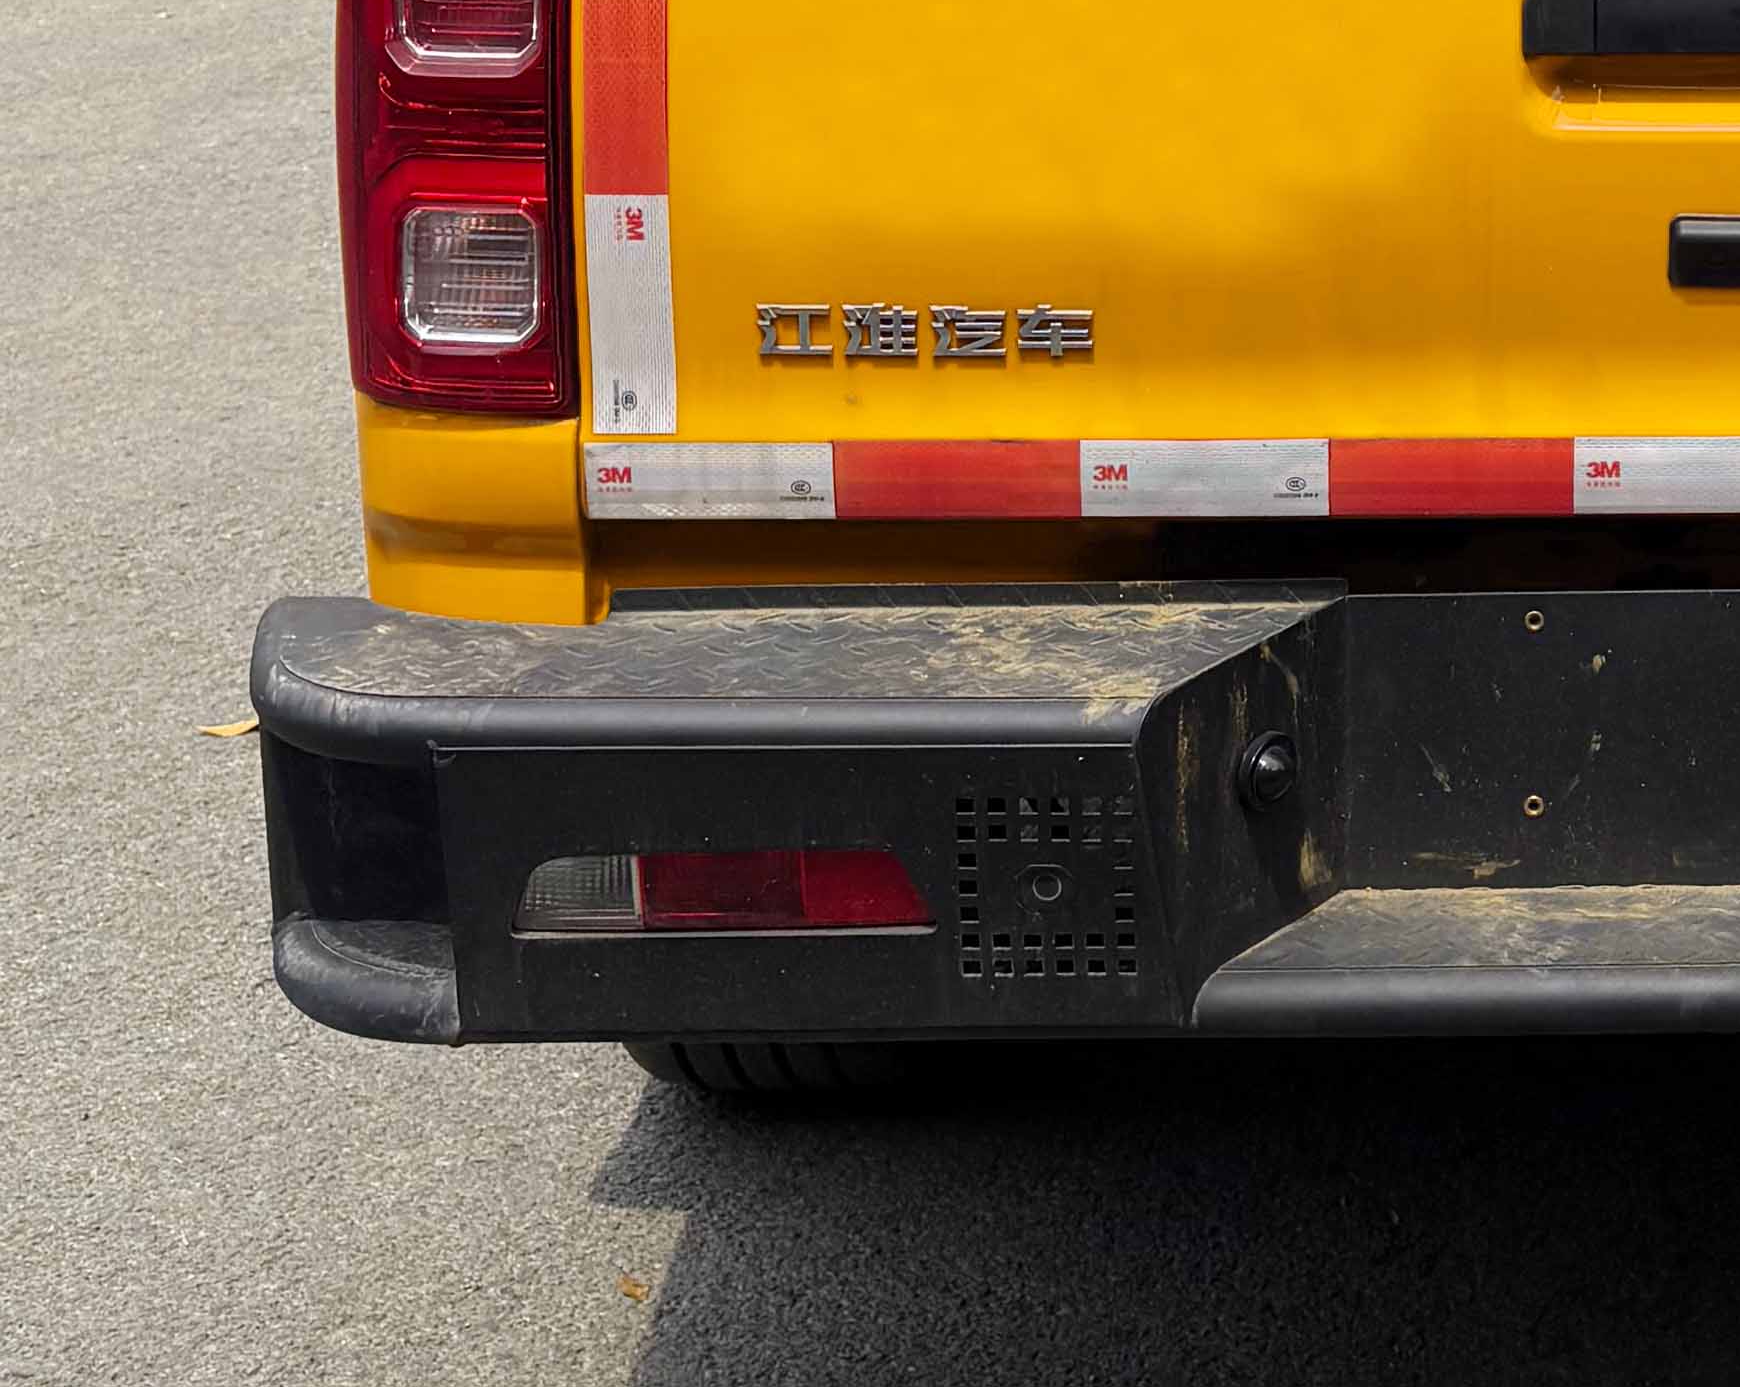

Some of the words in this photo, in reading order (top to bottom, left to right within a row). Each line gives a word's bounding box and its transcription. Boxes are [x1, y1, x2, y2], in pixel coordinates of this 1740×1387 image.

[625, 207, 646, 242] 3M
[756, 302, 1094, 357] 江淮汽车
[597, 466, 632, 485] 3M
[1093, 464, 1128, 482] 3M
[1586, 461, 1621, 479] 3M
